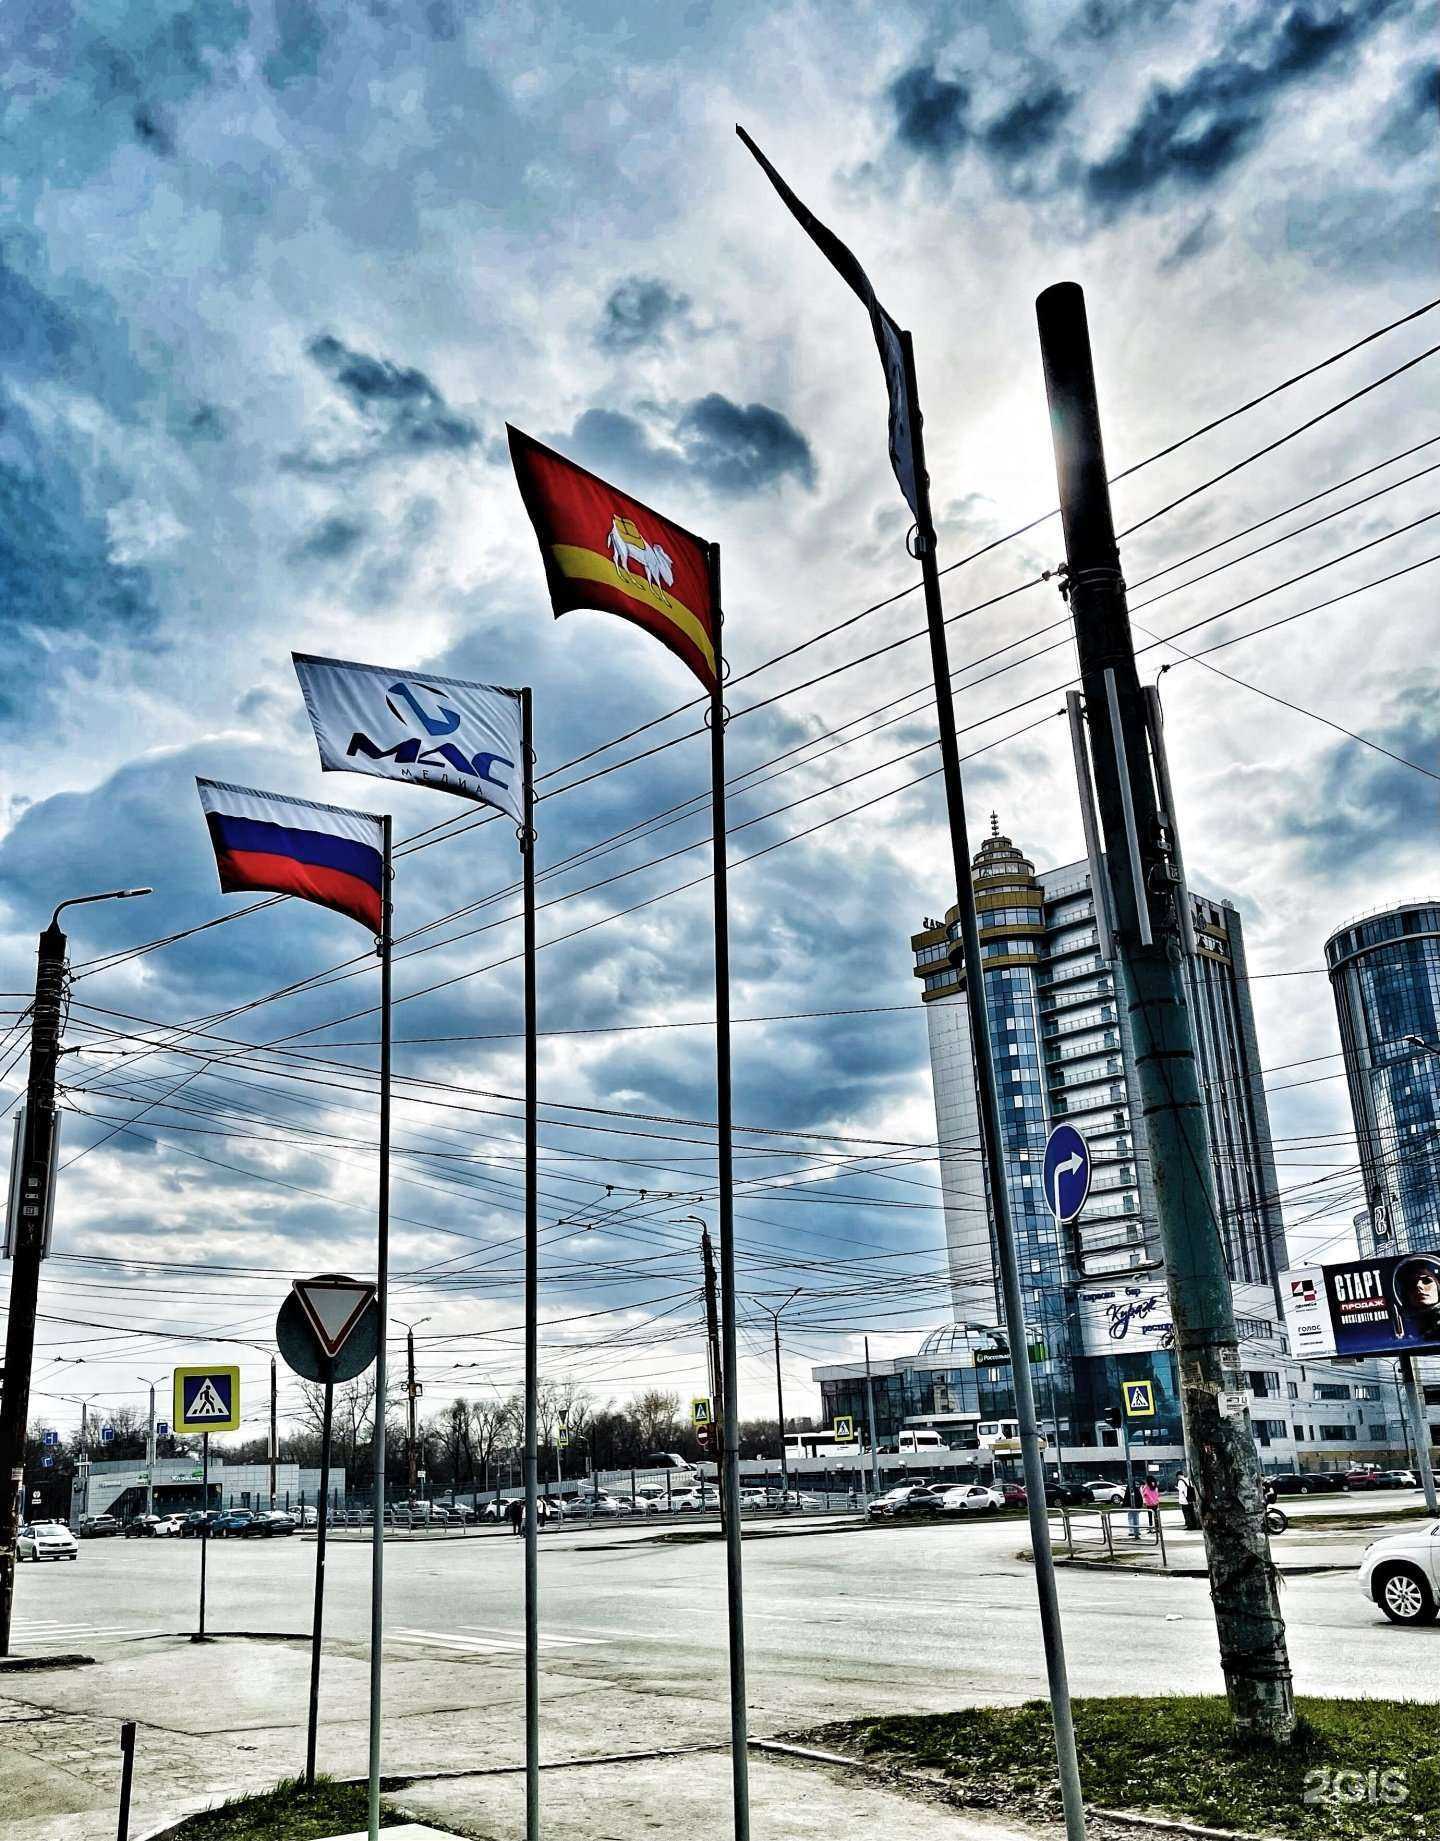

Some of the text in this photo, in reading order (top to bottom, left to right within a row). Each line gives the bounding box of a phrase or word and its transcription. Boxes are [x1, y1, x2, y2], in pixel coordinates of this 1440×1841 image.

[401, 767, 484, 796] МЕДИА
[1334, 1269, 1383, 1301] СТАРТ
[1341, 1299, 1385, 1311] ПРОДАЖ
